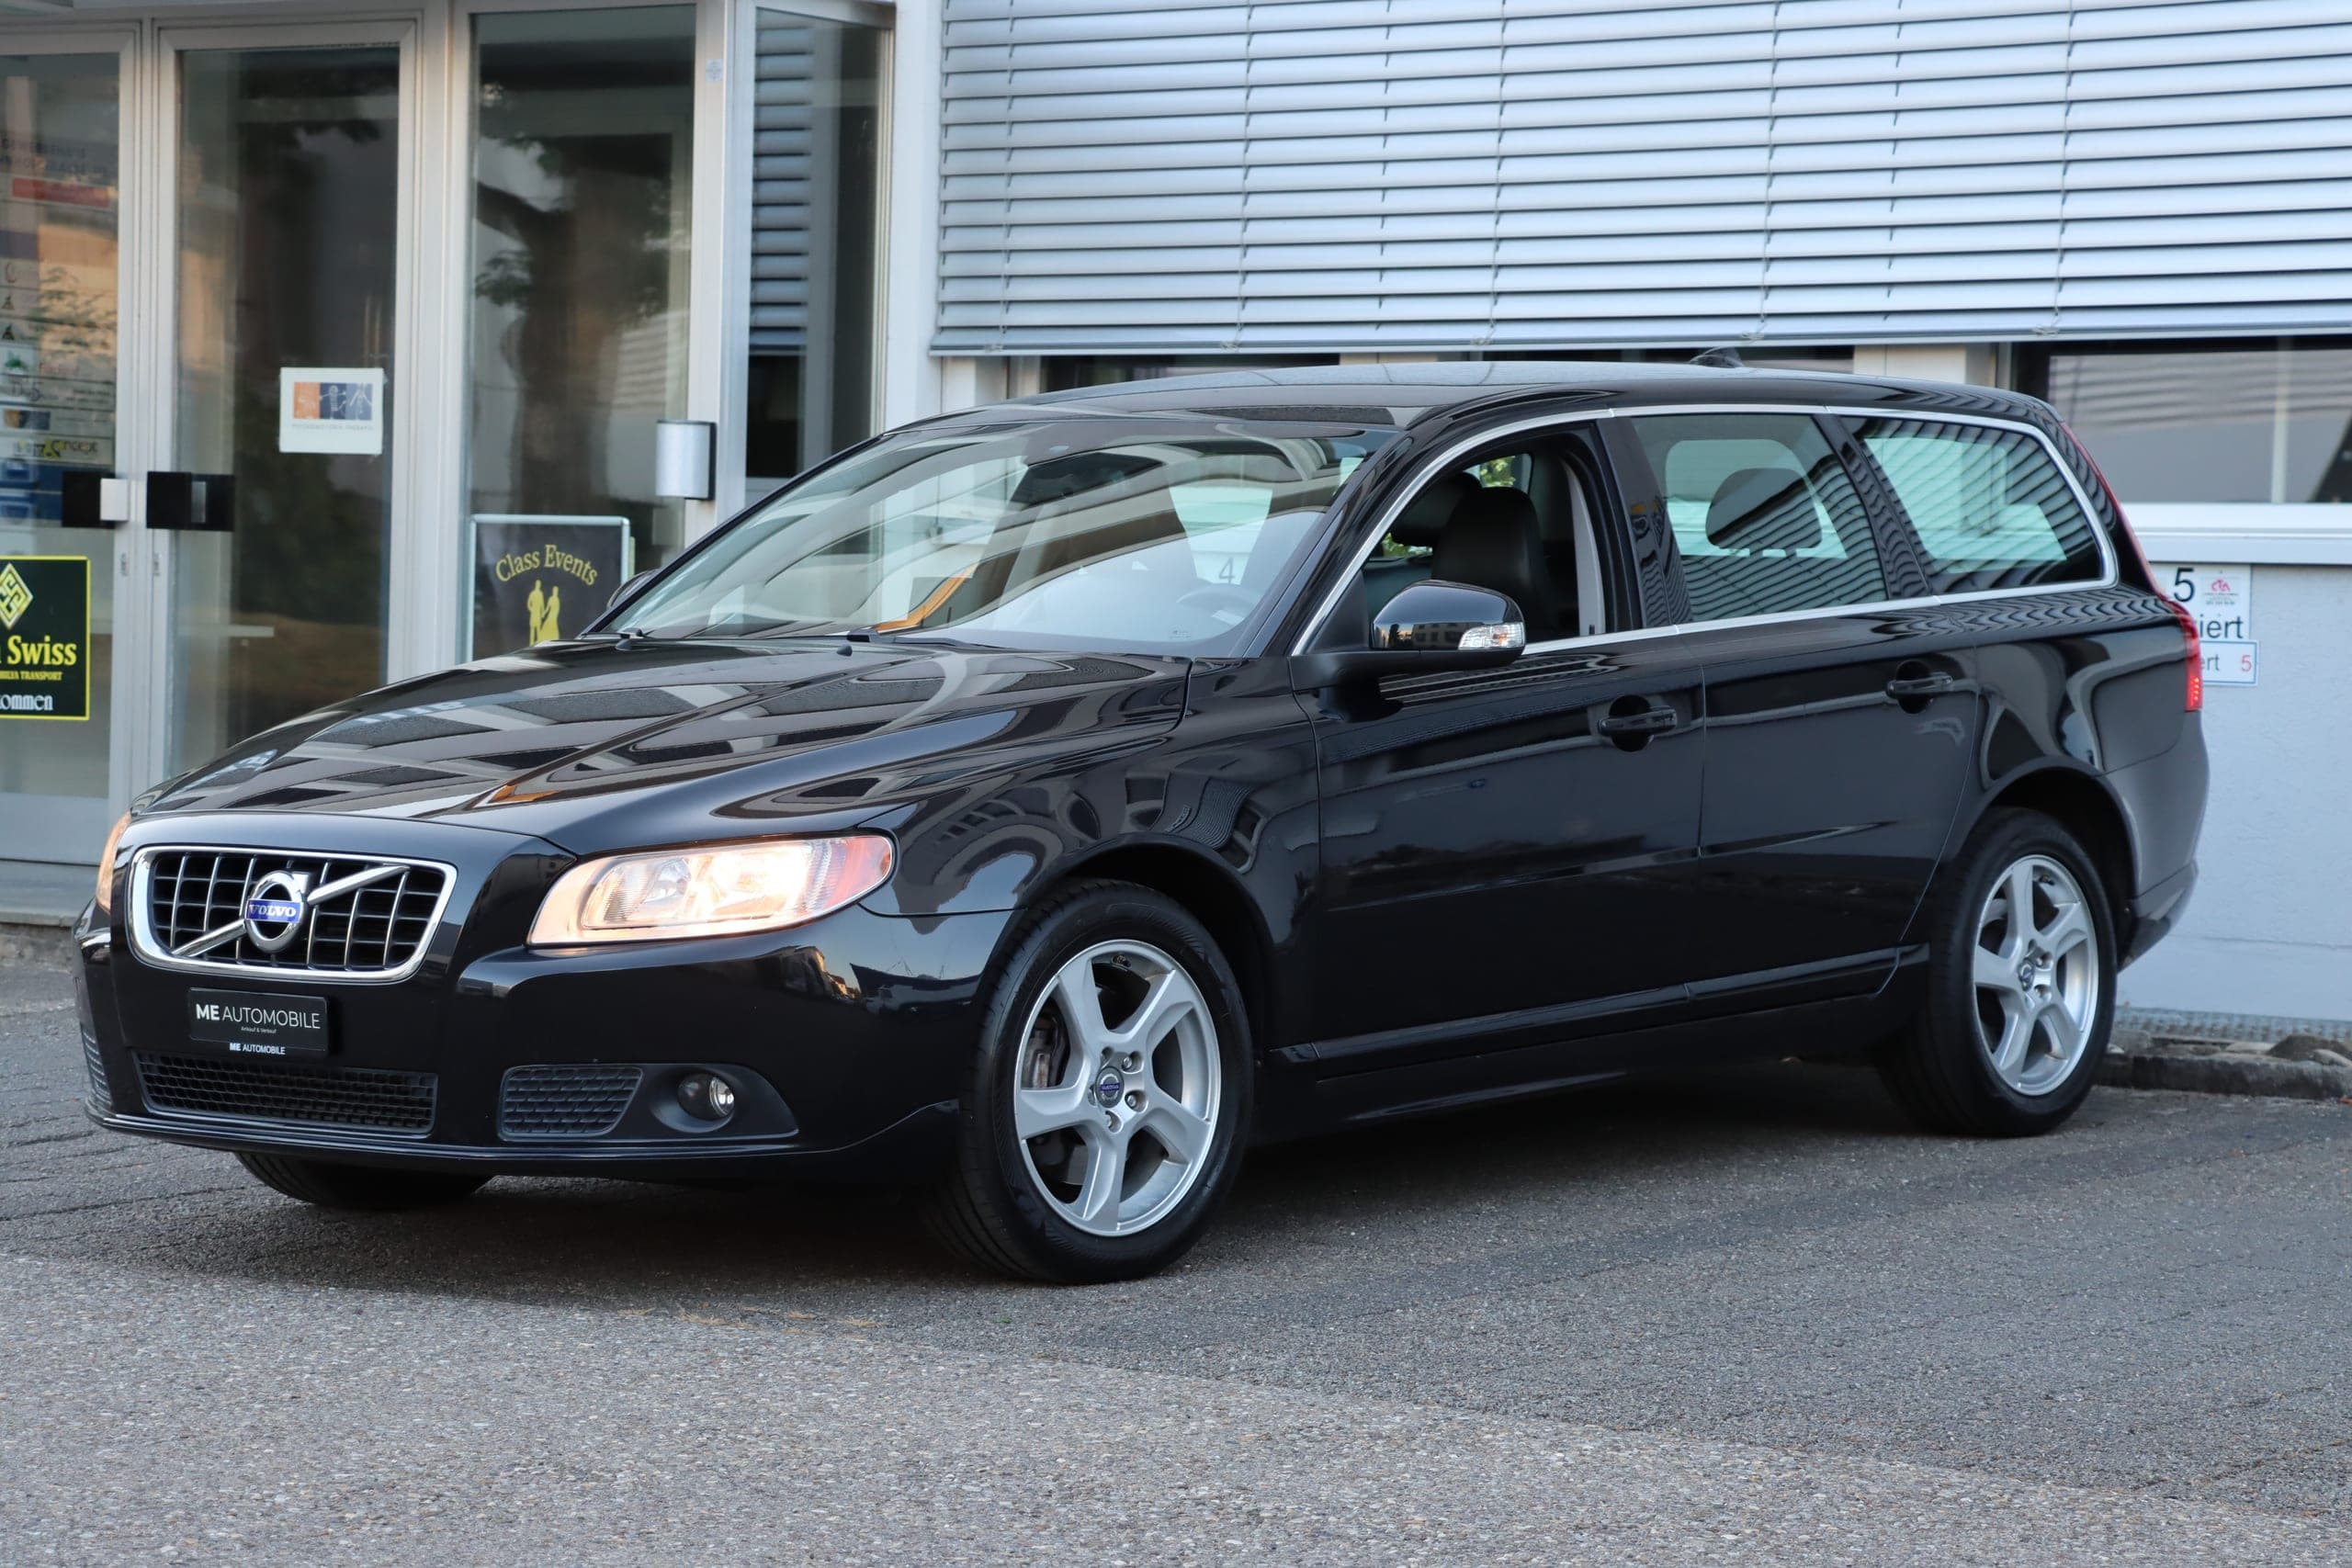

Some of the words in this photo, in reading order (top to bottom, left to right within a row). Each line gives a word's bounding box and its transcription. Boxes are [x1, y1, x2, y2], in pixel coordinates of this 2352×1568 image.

[496, 551, 540, 581] Class
[544, 544, 597, 586] Events
[1218, 557, 1236, 584] 4
[2174, 567, 2195, 603] 5
[2199, 613, 2244, 638] iert
[7, 635, 77, 665] Swiss
[2241, 654, 2252, 671] 5
[0, 694, 53, 711] ommen
[249, 904, 297, 918] VOLVO
[196, 1004, 220, 1021] ME
[222, 1007, 321, 1029] AUTOMOBILE
[230, 1042, 242, 1052] ME
[243, 1043, 286, 1055] AUTOMOBILE
